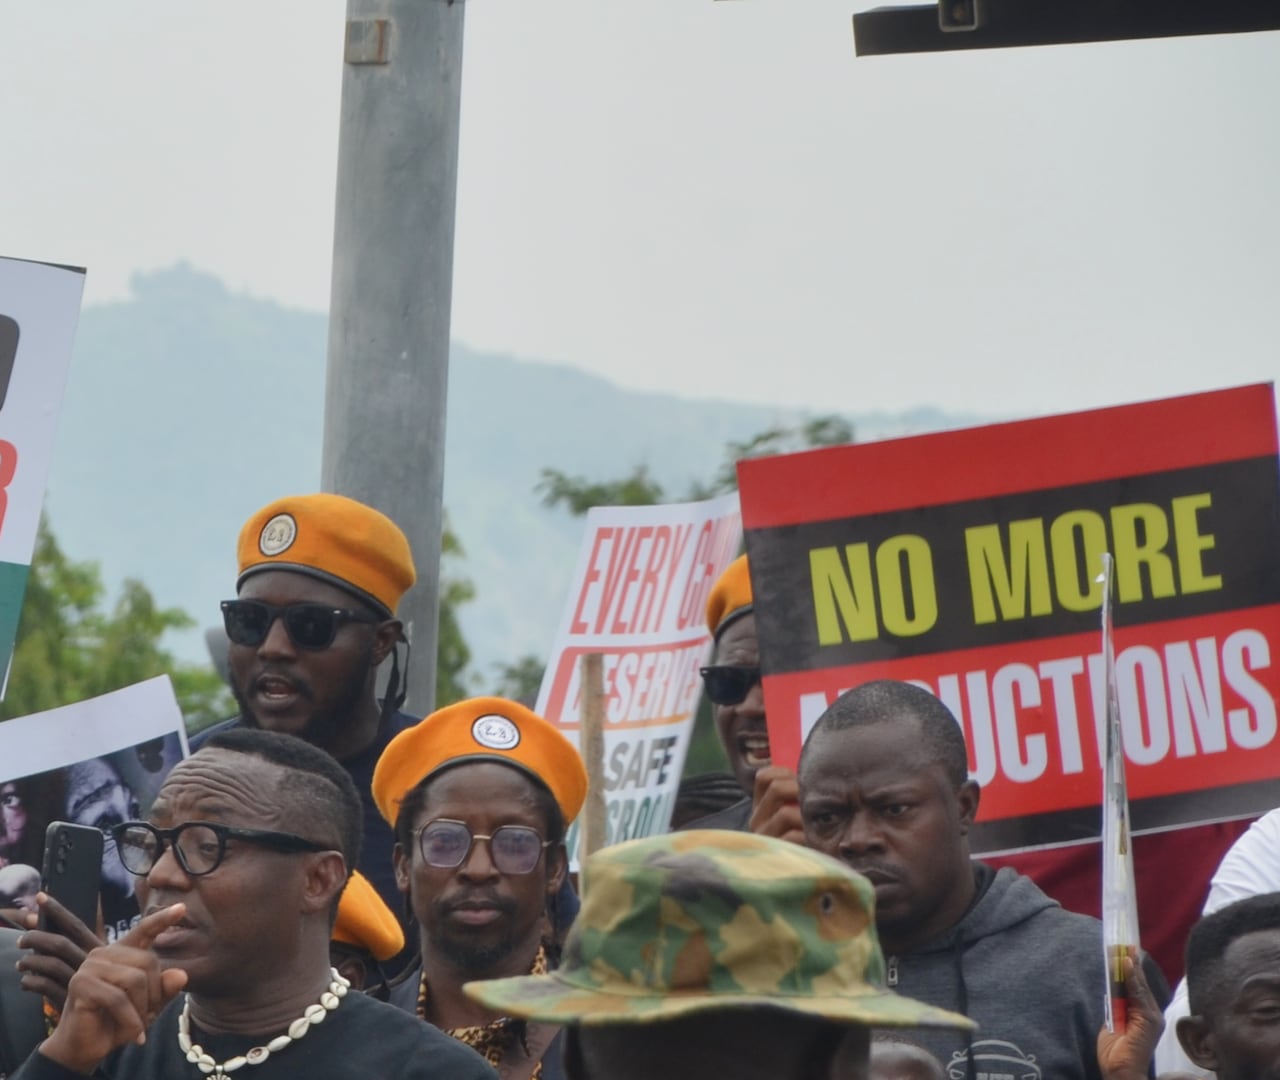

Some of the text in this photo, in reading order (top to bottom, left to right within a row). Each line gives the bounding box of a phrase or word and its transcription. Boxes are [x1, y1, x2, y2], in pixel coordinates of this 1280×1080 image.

[569, 526, 693, 635] EVERY
[808, 534, 938, 647] NO
[964, 493, 1223, 626] MORE
[604, 736, 677, 793] SAFE
